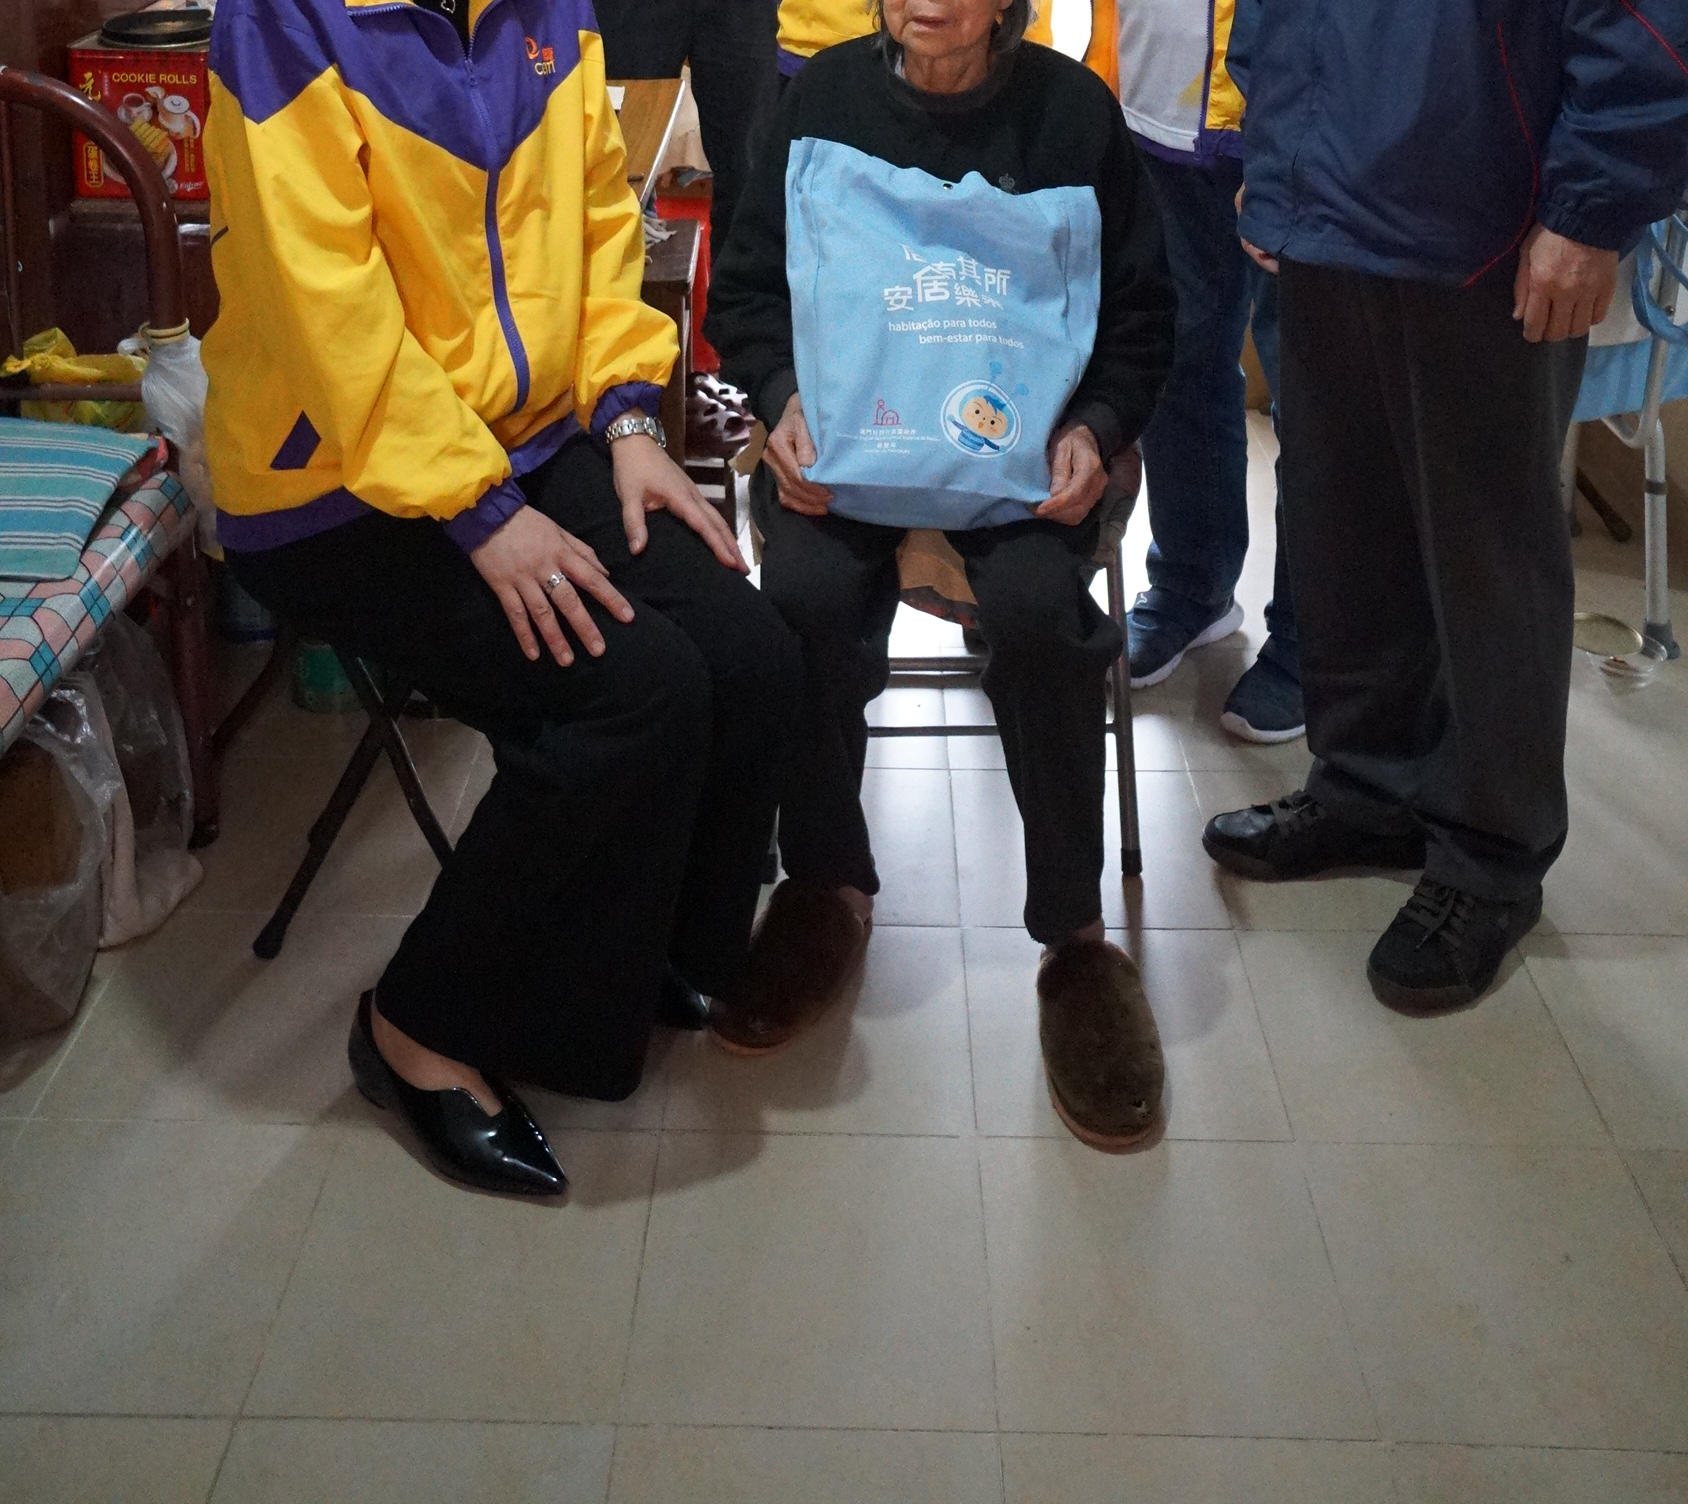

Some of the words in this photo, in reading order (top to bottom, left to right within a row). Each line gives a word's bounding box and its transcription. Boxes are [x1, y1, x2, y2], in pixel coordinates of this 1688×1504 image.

[112, 72, 156, 84] COOKIE
[159, 73, 198, 85] ROLLS
[888, 318, 941, 332] habitação
[943, 319, 966, 330] para
[968, 318, 998, 330] todos
[919, 333, 974, 344] bem-estar
[975, 333, 998, 344] para
[998, 335, 1025, 350] todos
